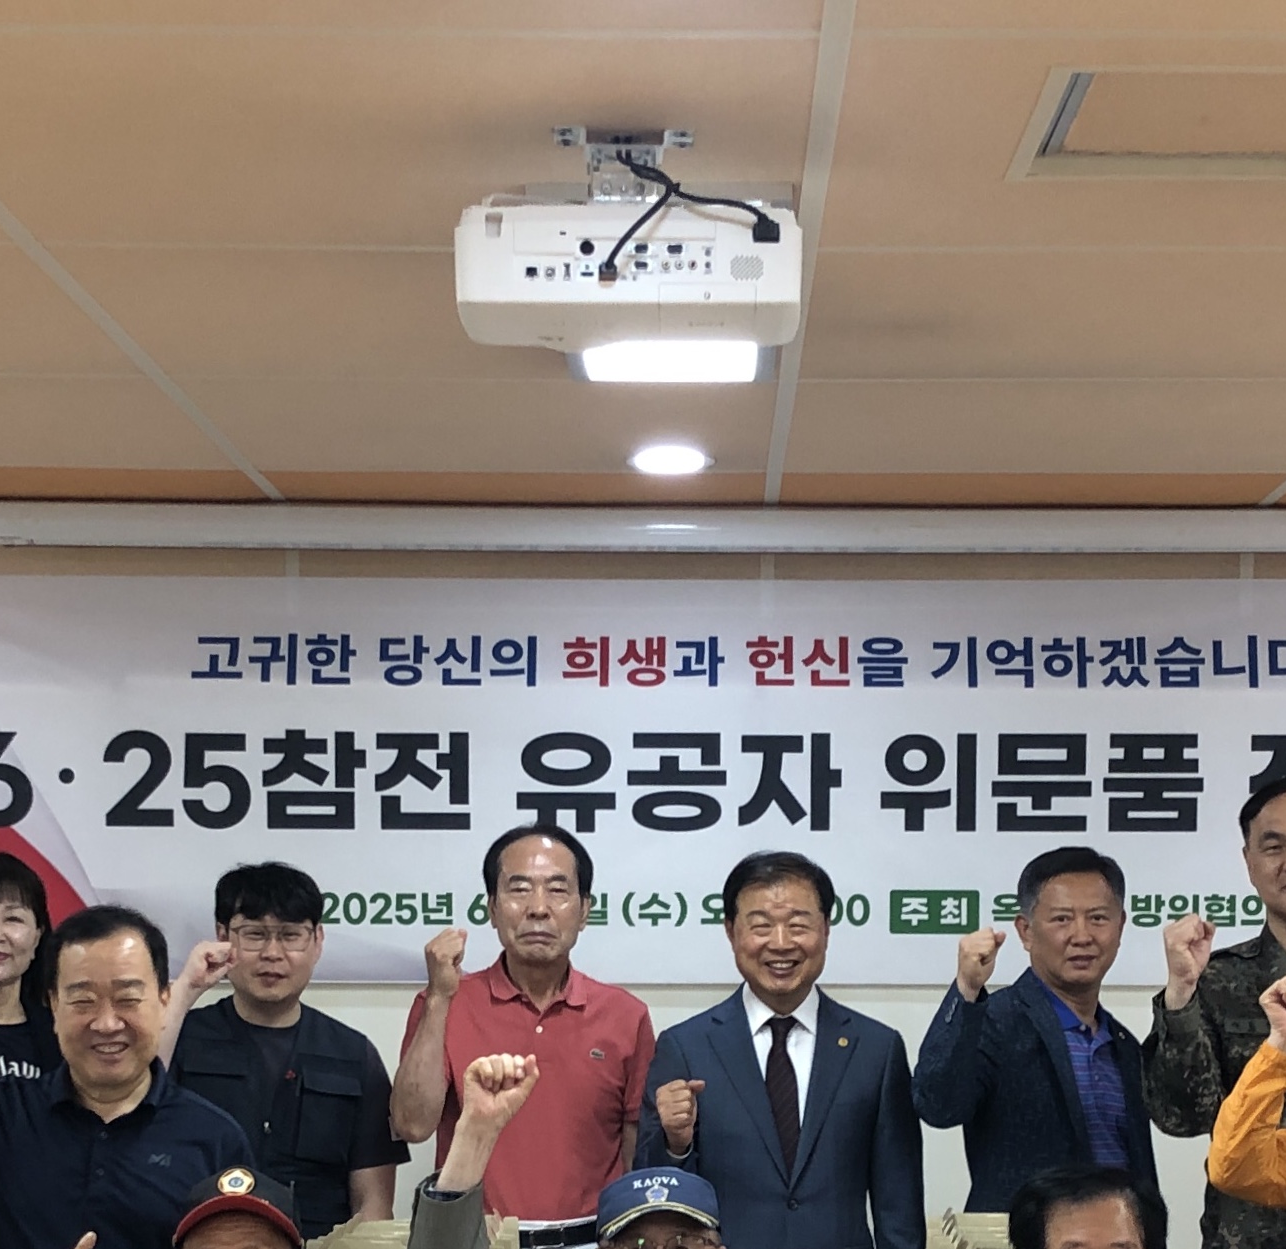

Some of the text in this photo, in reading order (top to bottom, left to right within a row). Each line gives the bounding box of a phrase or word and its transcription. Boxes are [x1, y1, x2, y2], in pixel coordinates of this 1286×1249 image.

[191, 633, 357, 686] 고귀한
[379, 634, 537, 687] 당신의
[562, 635, 725, 688] 희생과
[745, 635, 909, 688] 헌신을
[515, 730, 843, 833] 유공자
[880, 733, 1205, 832] 위문품
[321, 892, 454, 925] 2025년
[466, 893, 491, 925] 6
[622, 891, 689, 927] (수)
[1131, 894, 1265, 928] 방위협의
[632, 1175, 679, 1189] KAOVA
